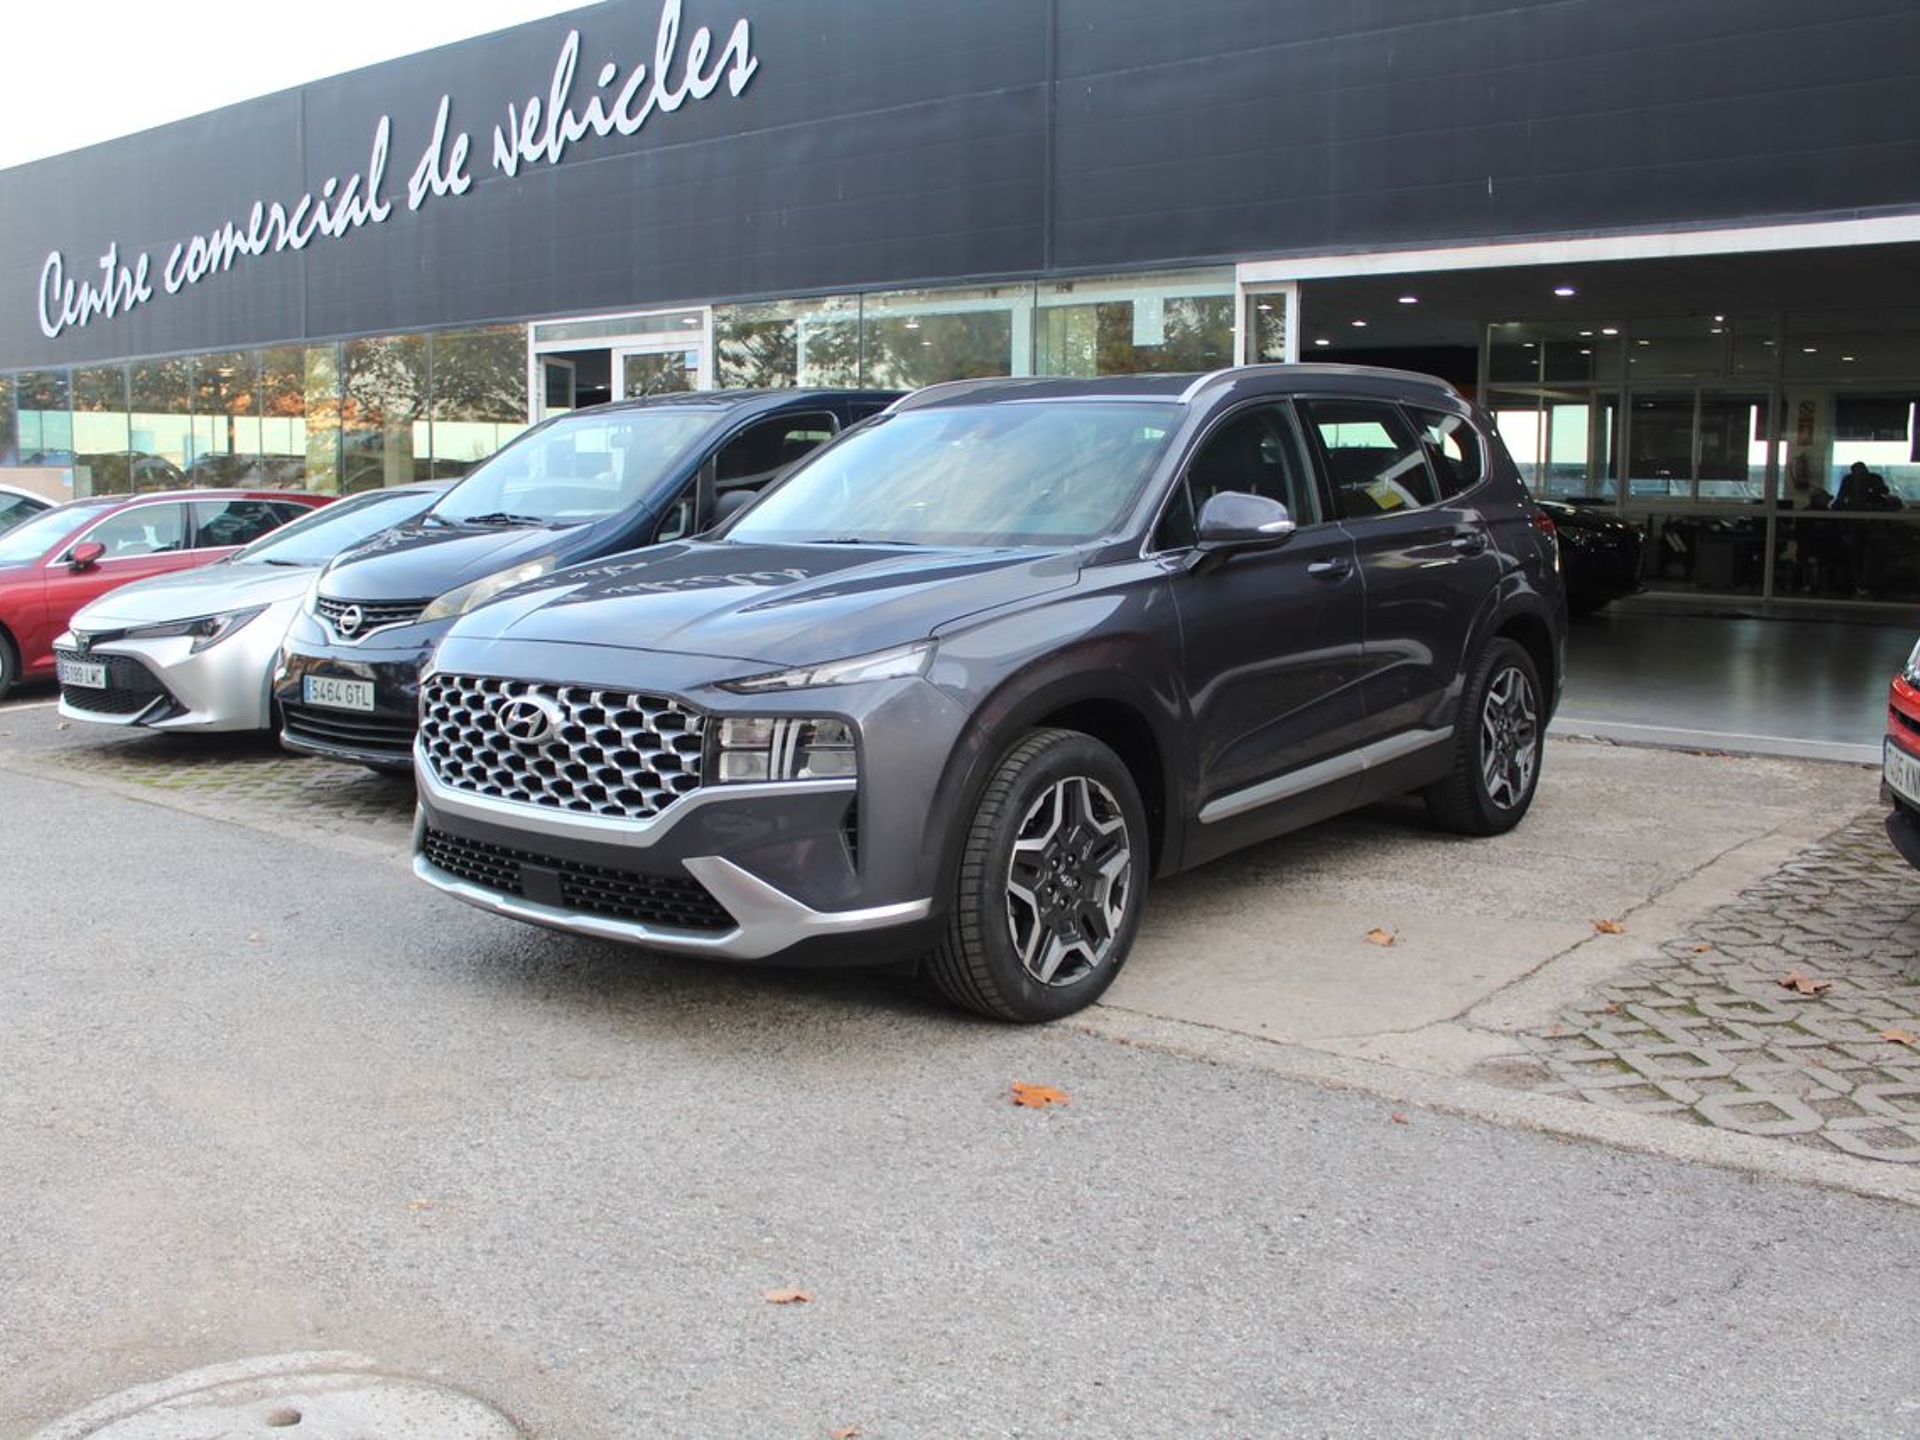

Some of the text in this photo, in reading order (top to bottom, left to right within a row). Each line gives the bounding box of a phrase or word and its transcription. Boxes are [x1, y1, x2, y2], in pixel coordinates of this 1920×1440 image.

[38, 0, 759, 339] Centre comercial de vehicles
[312, 679, 371, 707] 5464 GTL
